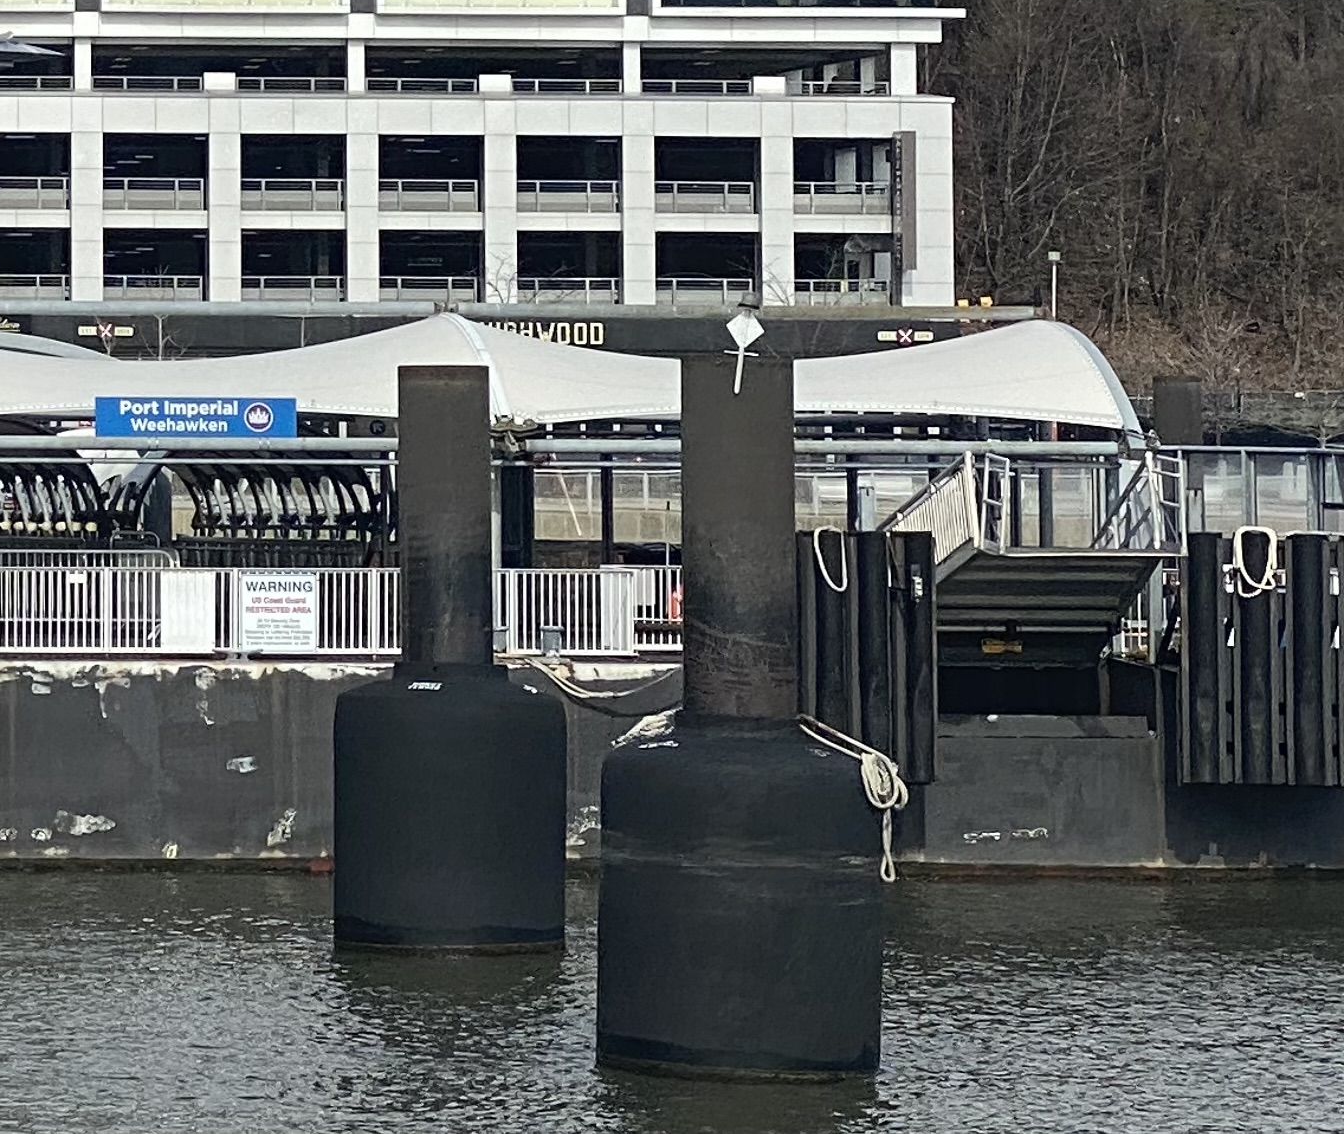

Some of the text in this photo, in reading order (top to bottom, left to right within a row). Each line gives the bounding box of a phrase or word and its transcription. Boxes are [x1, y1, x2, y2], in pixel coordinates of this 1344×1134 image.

[481, 322, 604, 345] HWOOD
[120, 400, 239, 419] Port Imperial
[130, 418, 228, 432] Weehawken
[245, 581, 313, 592] WARNING
